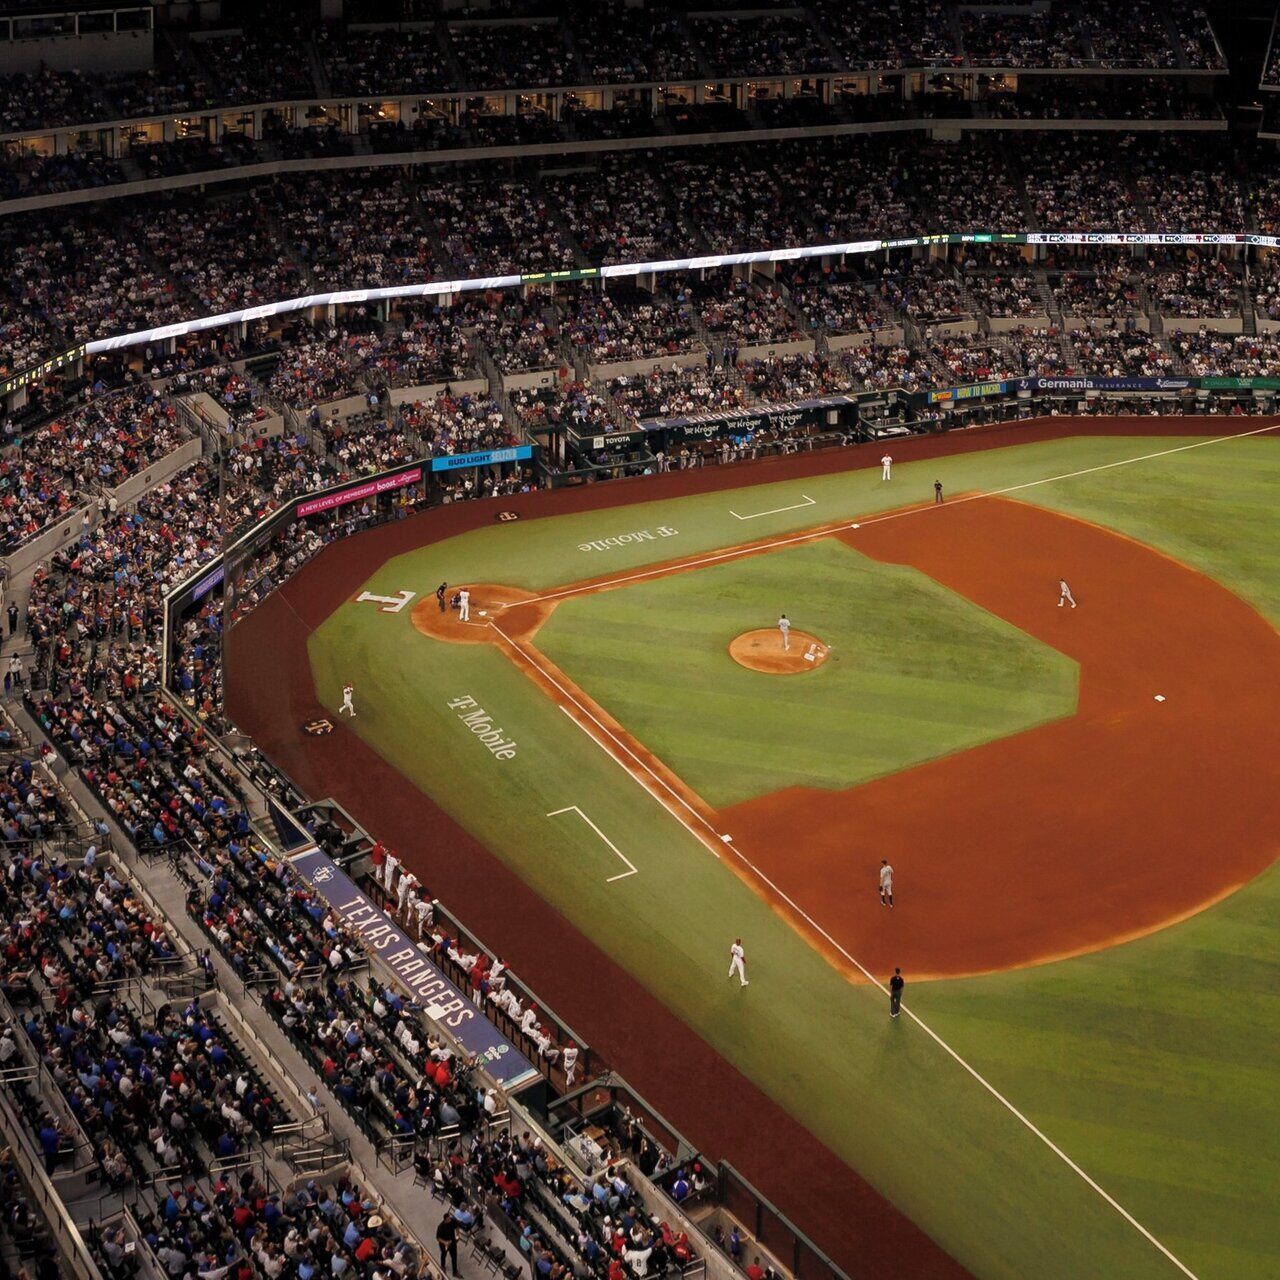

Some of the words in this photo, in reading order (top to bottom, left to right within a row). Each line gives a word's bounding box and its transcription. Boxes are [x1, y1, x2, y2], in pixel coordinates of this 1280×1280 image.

[1038, 379, 1093, 388] Germania
[737, 419, 761, 431] Kroger
[779, 413, 802, 425] Kroger
[694, 424, 719, 437] Kroger
[606, 436, 630, 445] TOYOTA
[448, 457, 466, 467] BUD
[467, 455, 490, 463] LIGHT
[306, 504, 319, 512] NEW
[320, 500, 334, 508] LEVEL
[343, 486, 374, 500] MEMBERSHIP
[377, 480, 396, 490] boost
[578, 530, 657, 551] Mobile
[356, 590, 416, 613] T
[457, 708, 517, 760] Mobile
[339, 895, 400, 949] TEXAS
[386, 948, 474, 1028] RANGERS
